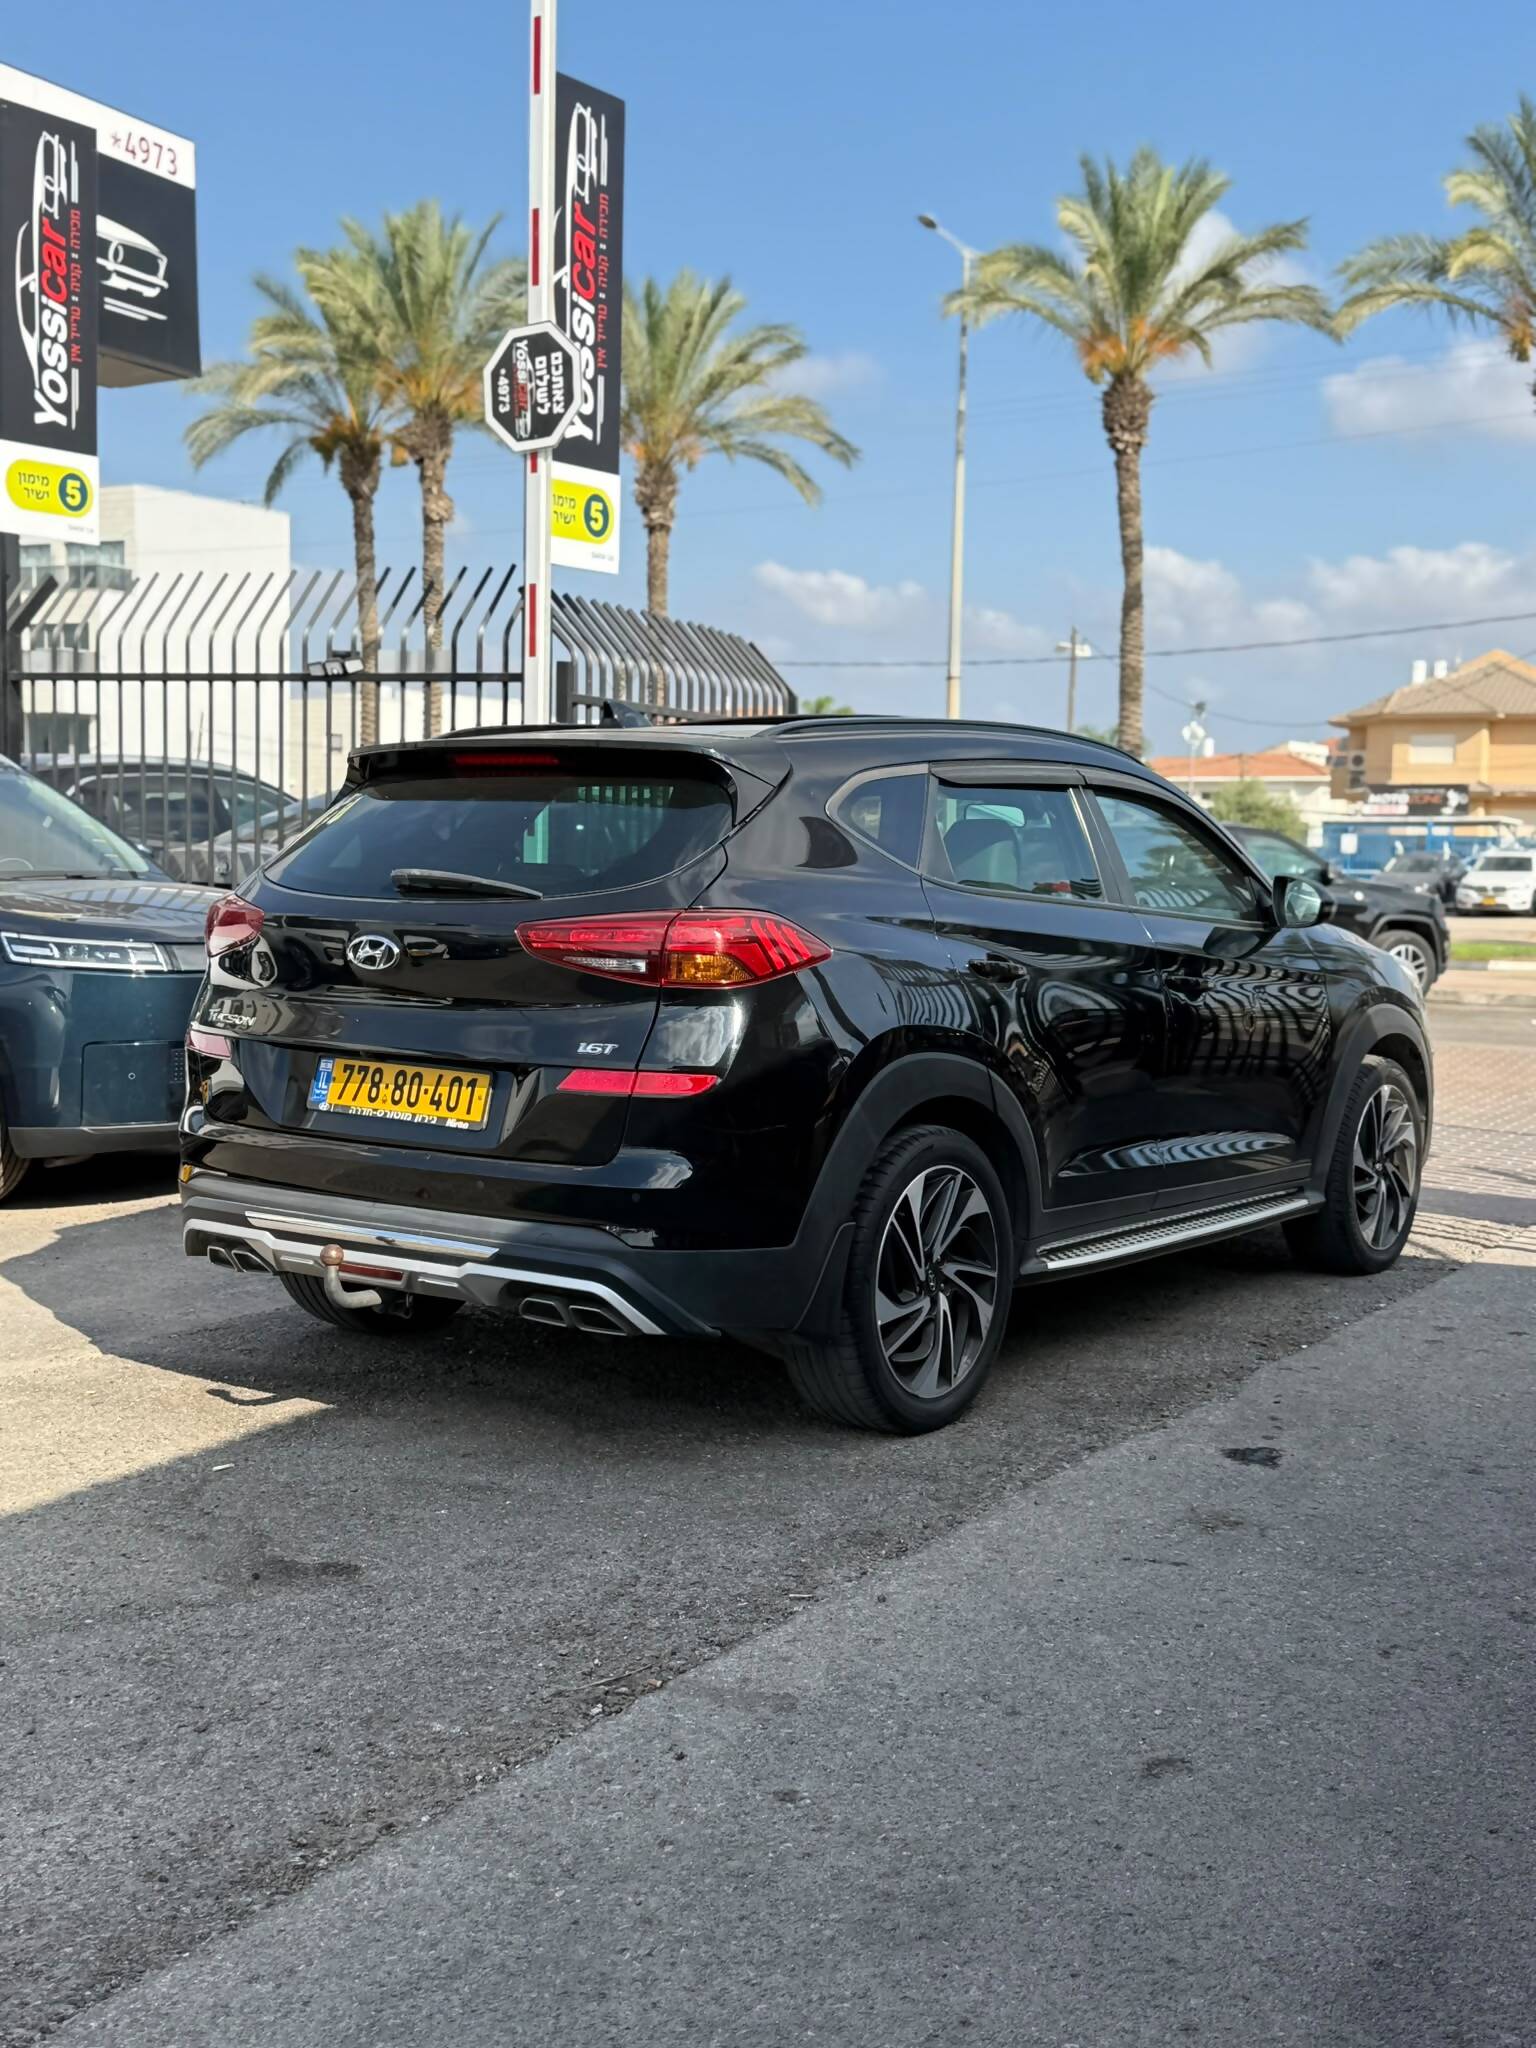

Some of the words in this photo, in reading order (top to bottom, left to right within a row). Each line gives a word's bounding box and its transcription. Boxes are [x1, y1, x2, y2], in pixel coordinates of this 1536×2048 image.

[70, 209, 81, 249] מכירה
[598, 193, 610, 239] מכירה
[70, 262, 82, 298] קניה
[598, 254, 610, 288] קניה
[34, 216, 68, 427] Yossicar
[70, 306, 81, 340] טרייד
[535, 355, 551, 415] לשלום
[550, 351, 565, 415] צאתכם
[18, 471, 50, 487] מימון
[23, 486, 50, 501] ישיר
[552, 493, 577, 510] מימו
[552, 509, 576, 525] ישיר
